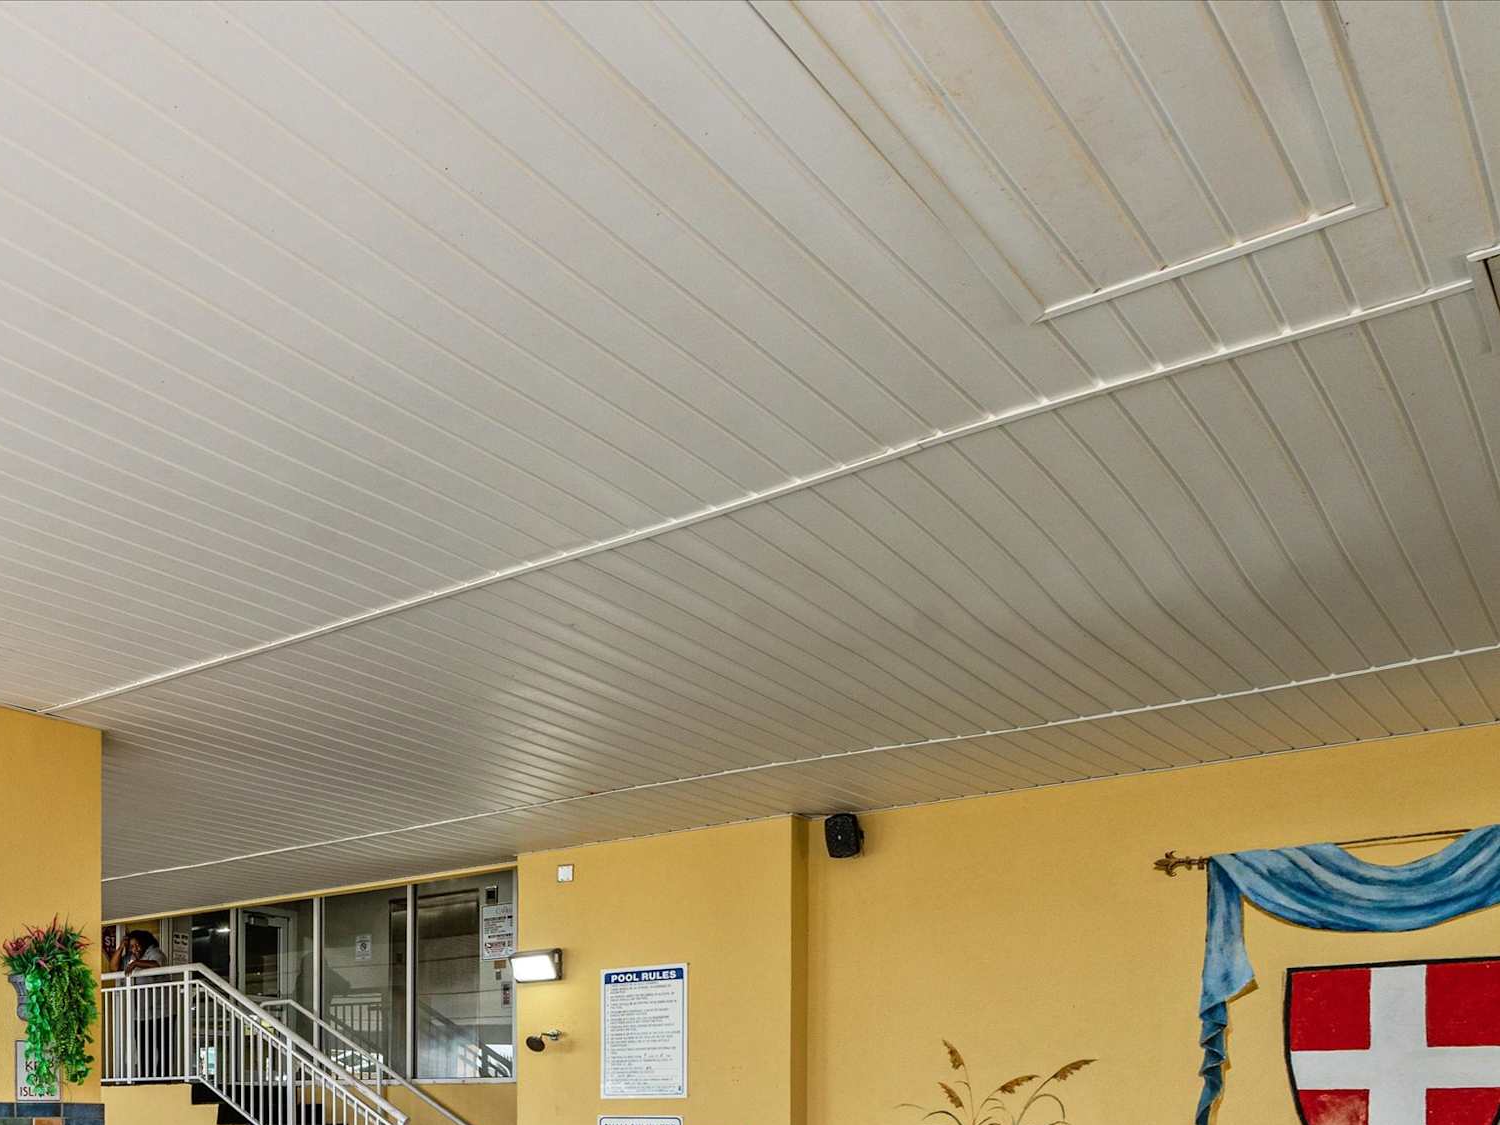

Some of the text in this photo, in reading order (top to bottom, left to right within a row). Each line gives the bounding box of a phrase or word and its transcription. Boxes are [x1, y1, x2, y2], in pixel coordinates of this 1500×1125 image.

[611, 970, 677, 982] POOL RULES
[20, 1086, 55, 1097] ISL
